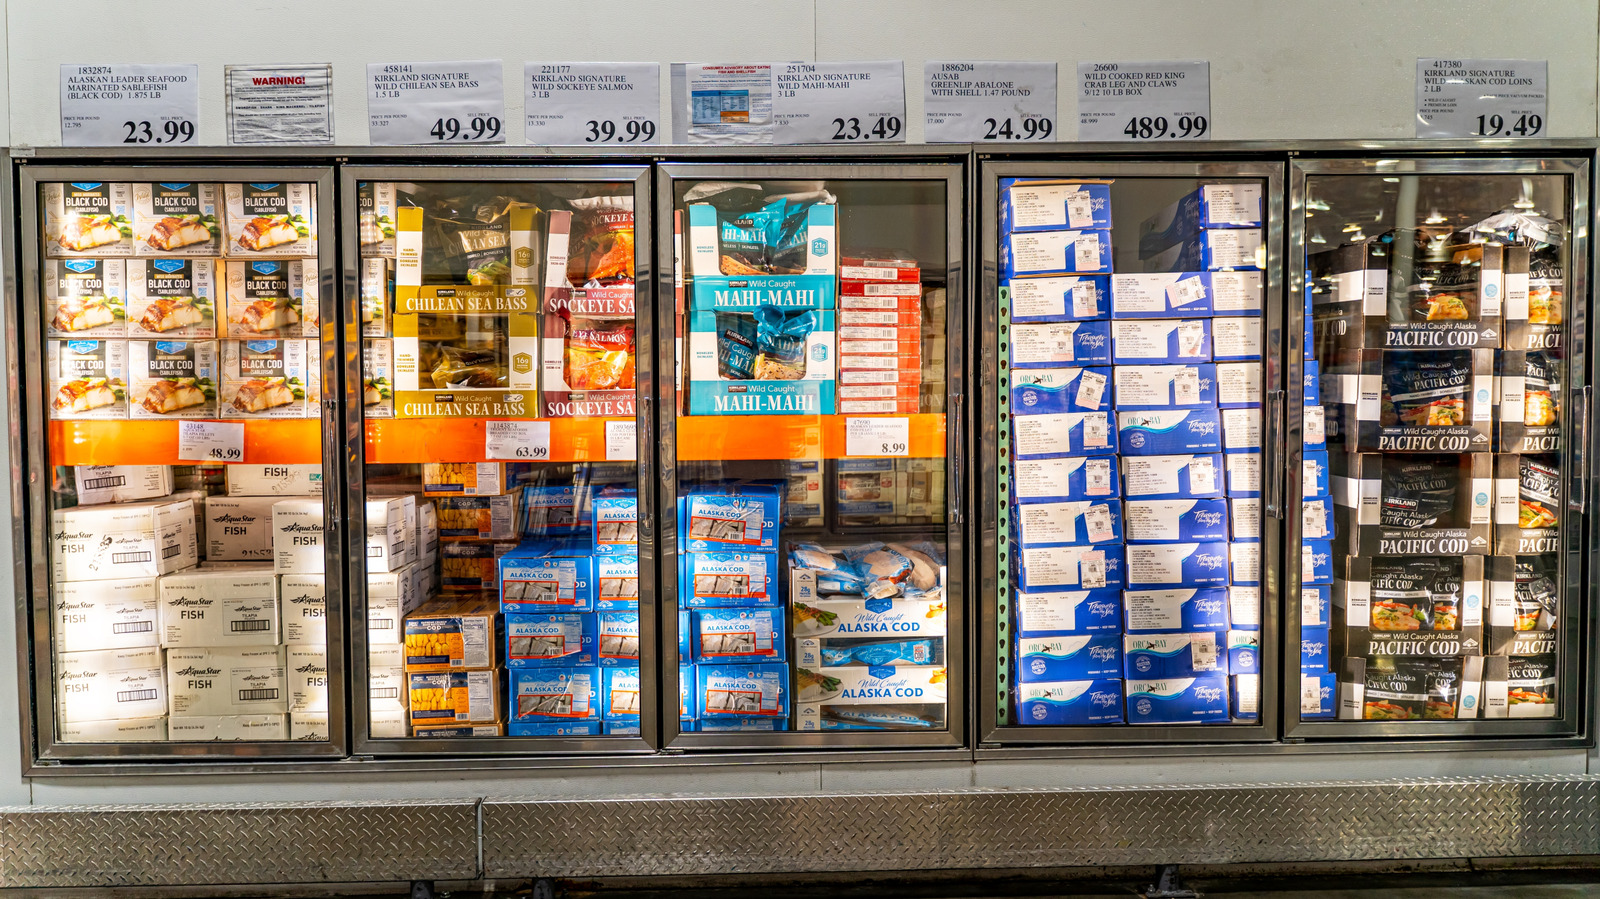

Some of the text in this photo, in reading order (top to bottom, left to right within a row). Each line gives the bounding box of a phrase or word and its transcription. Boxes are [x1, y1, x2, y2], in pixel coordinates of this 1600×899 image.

[252, 76, 306, 85] WARNING!
[374, 72, 470, 82] KIRKLAND SIGNATURE
[375, 82, 397, 90] WILD
[68, 92, 99, 100] (BLACK
[430, 117, 501, 140] 49.99
[832, 117, 901, 140] 23.49
[984, 118, 1052, 140] 24.99
[1124, 116, 1207, 139] 489.99
[1476, 114, 1542, 136] 19.49
[122, 121, 194, 144] 23.99
[585, 120, 655, 143] 39.99
[66, 197, 108, 206] BLACK COD
[154, 197, 197, 206] BLACK COD
[245, 198, 286, 206] BLACK COD
[149, 279, 190, 288] BLACK COD
[768, 280, 796, 289] Caught
[714, 290, 814, 306] MAHI-MAHI
[406, 297, 527, 310] CHILEAN SEA BASS
[550, 299, 614, 313] SOCKEYE
[1428, 323, 1453, 331] Caught
[1386, 331, 1478, 346] PACIFIC COD
[241, 360, 282, 369] BLACK COD
[714, 395, 813, 412] MAHI-MAHI
[882, 443, 905, 453] 8.99
[1378, 436, 1469, 450] PACIFIC COD
[209, 448, 240, 459] 48.99
[516, 447, 547, 457] 63.99
[264, 468, 288, 476] FISH
[1384, 498, 1416, 506] KIRKLAND
[854, 613, 903, 625] Wild Caught
[838, 622, 920, 632] ALASKA COD
[1368, 641, 1460, 655] PACIFIC COD
[188, 680, 212, 688] FISH
[842, 688, 923, 698] ALASKA COD
